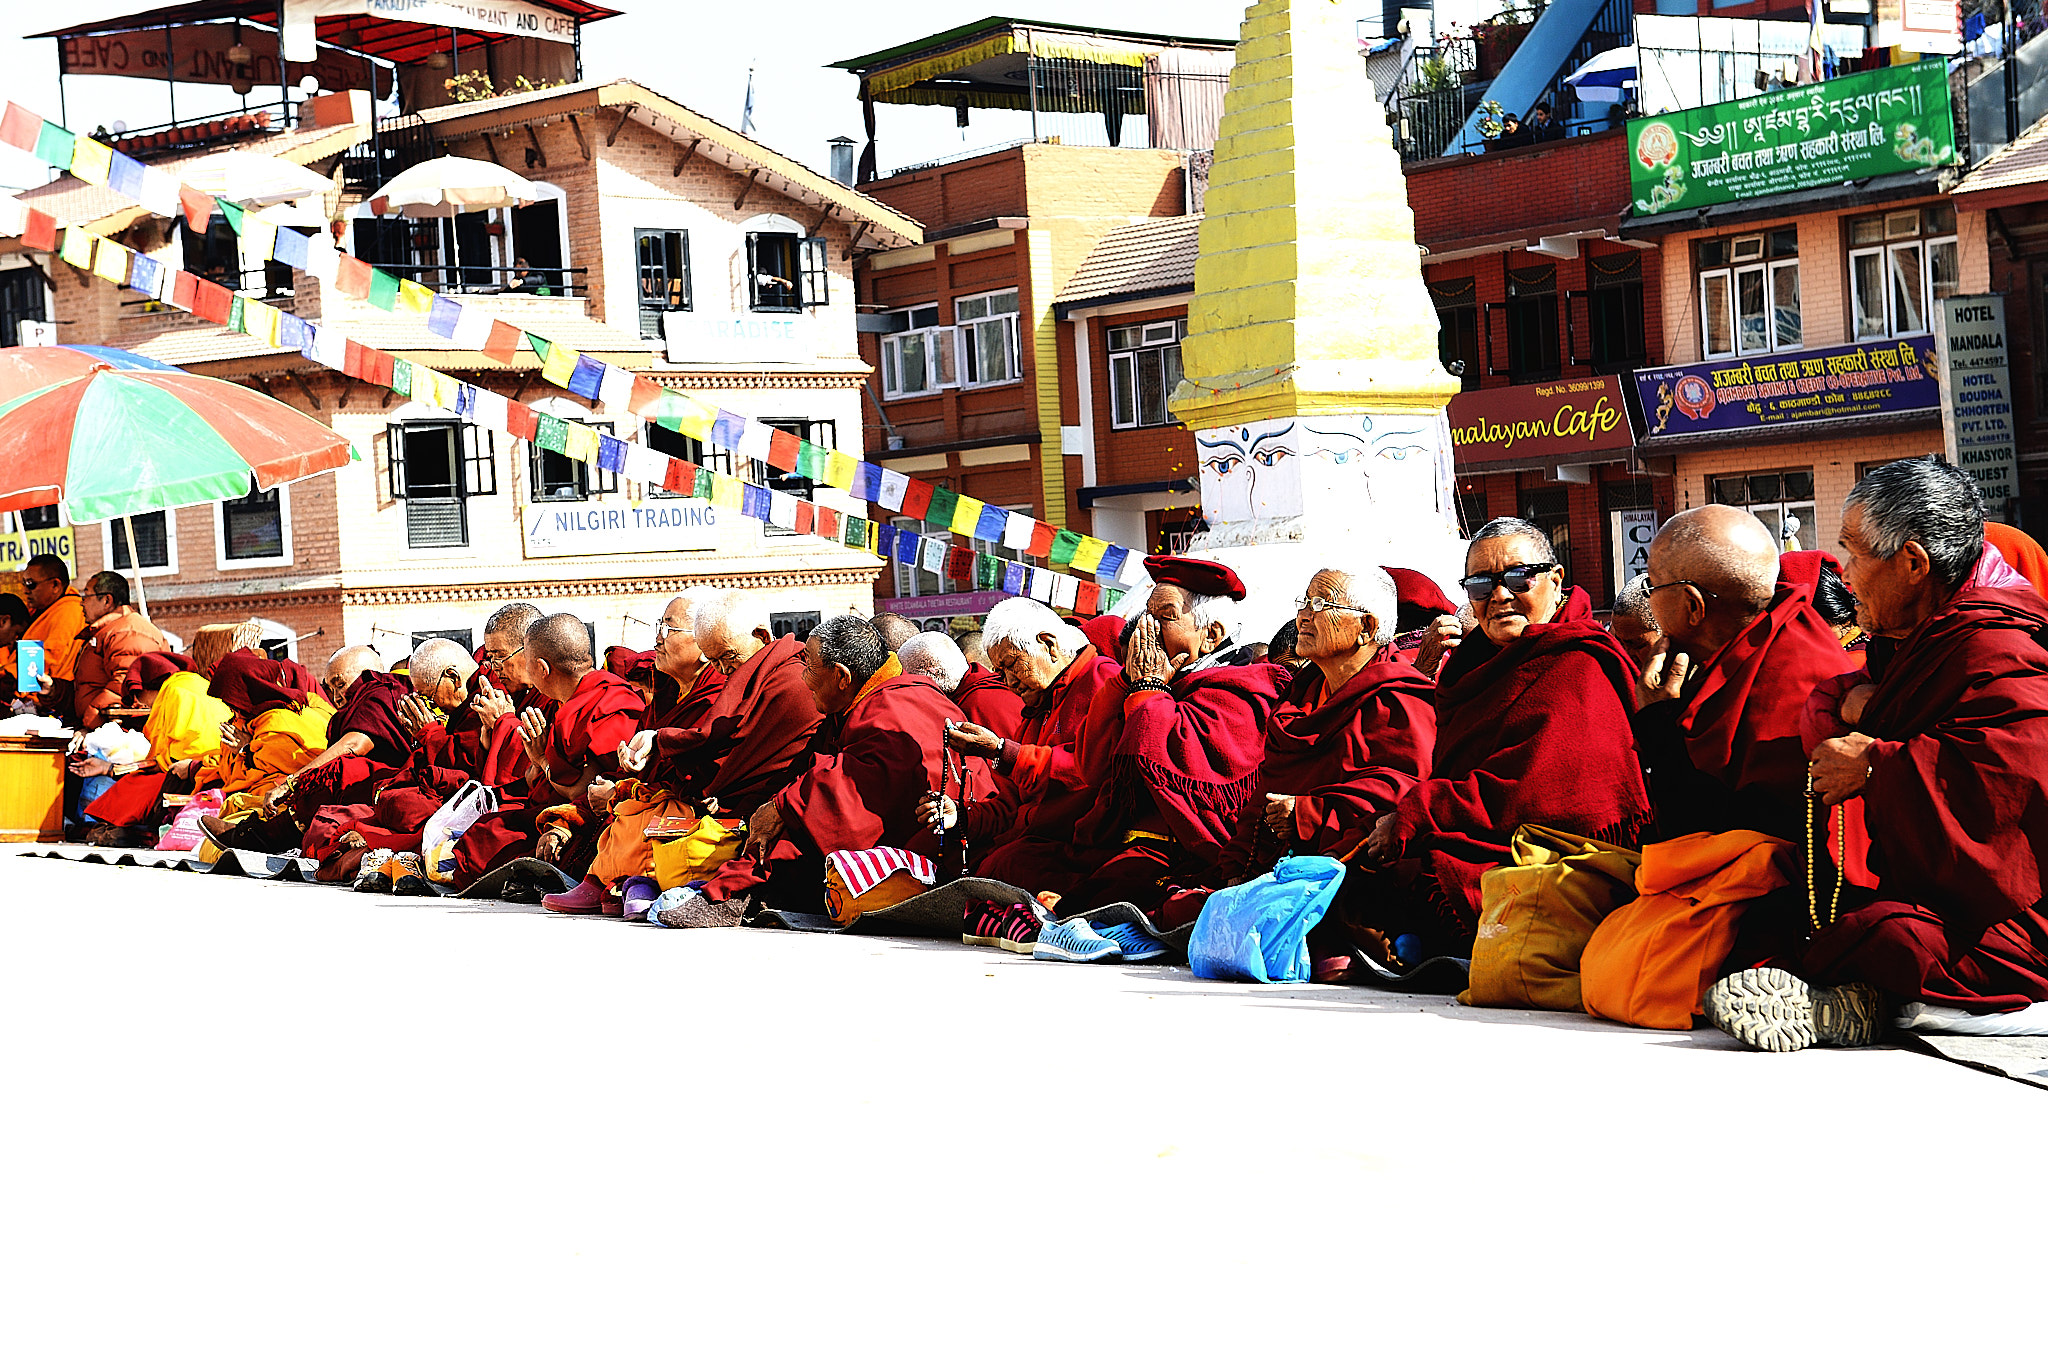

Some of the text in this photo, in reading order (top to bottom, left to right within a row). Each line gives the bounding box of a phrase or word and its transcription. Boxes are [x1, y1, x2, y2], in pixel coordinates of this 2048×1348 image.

[366, 0, 427, 11] PARADI
[516, 13, 538, 31] AND
[545, 16, 575, 36] CAFE
[1690, 150, 1730, 179] अजम्बरी
[1731, 153, 1753, 172] बचत
[1754, 147, 1774, 169] तथा
[1775, 143, 1798, 164] ऋण
[1800, 130, 1839, 161] सहकारी
[1840, 129, 1868, 153] संस्था
[1868, 121, 1886, 146] लि.
[1954, 306, 1995, 323] HOTEL
[688, 319, 795, 339] ARADISE
[1950, 333, 2003, 352] MANDALA
[1710, 362, 1754, 388] अजम्बरी
[1754, 364, 1778, 383] बचत
[1778, 361, 1800, 381] तथा
[1800, 358, 1826, 377] ऋण
[1825, 348, 1868, 376] सहकारी
[1869, 347, 1899, 371] संस्था
[1898, 341, 1919, 365] लि.
[1716, 384, 1757, 405] AJAMBARI
[1757, 380, 1788, 399] SAVING
[1788, 380, 1796, 394] &
[1796, 375, 1826, 394] CREDIT
[1826, 369, 1887, 391] CO-OPERATIVE
[1887, 366, 1905, 383] Pvt.
[1905, 364, 1924, 380] Ltd.
[1962, 373, 1997, 387] HOTEL
[1536, 386, 1555, 397] Regd.
[1556, 385, 1568, 394] No.
[1959, 388, 2003, 403] BOUDHA
[1954, 403, 2010, 417] CHHORTEN
[1451, 396, 1623, 449] malayan Cafe
[1961, 419, 2007, 433] PVT. LTD.
[1962, 447, 2013, 464] KHASYOR
[1979, 484, 2011, 500] OUSE
[555, 506, 716, 532] NILGIRI TRADING
